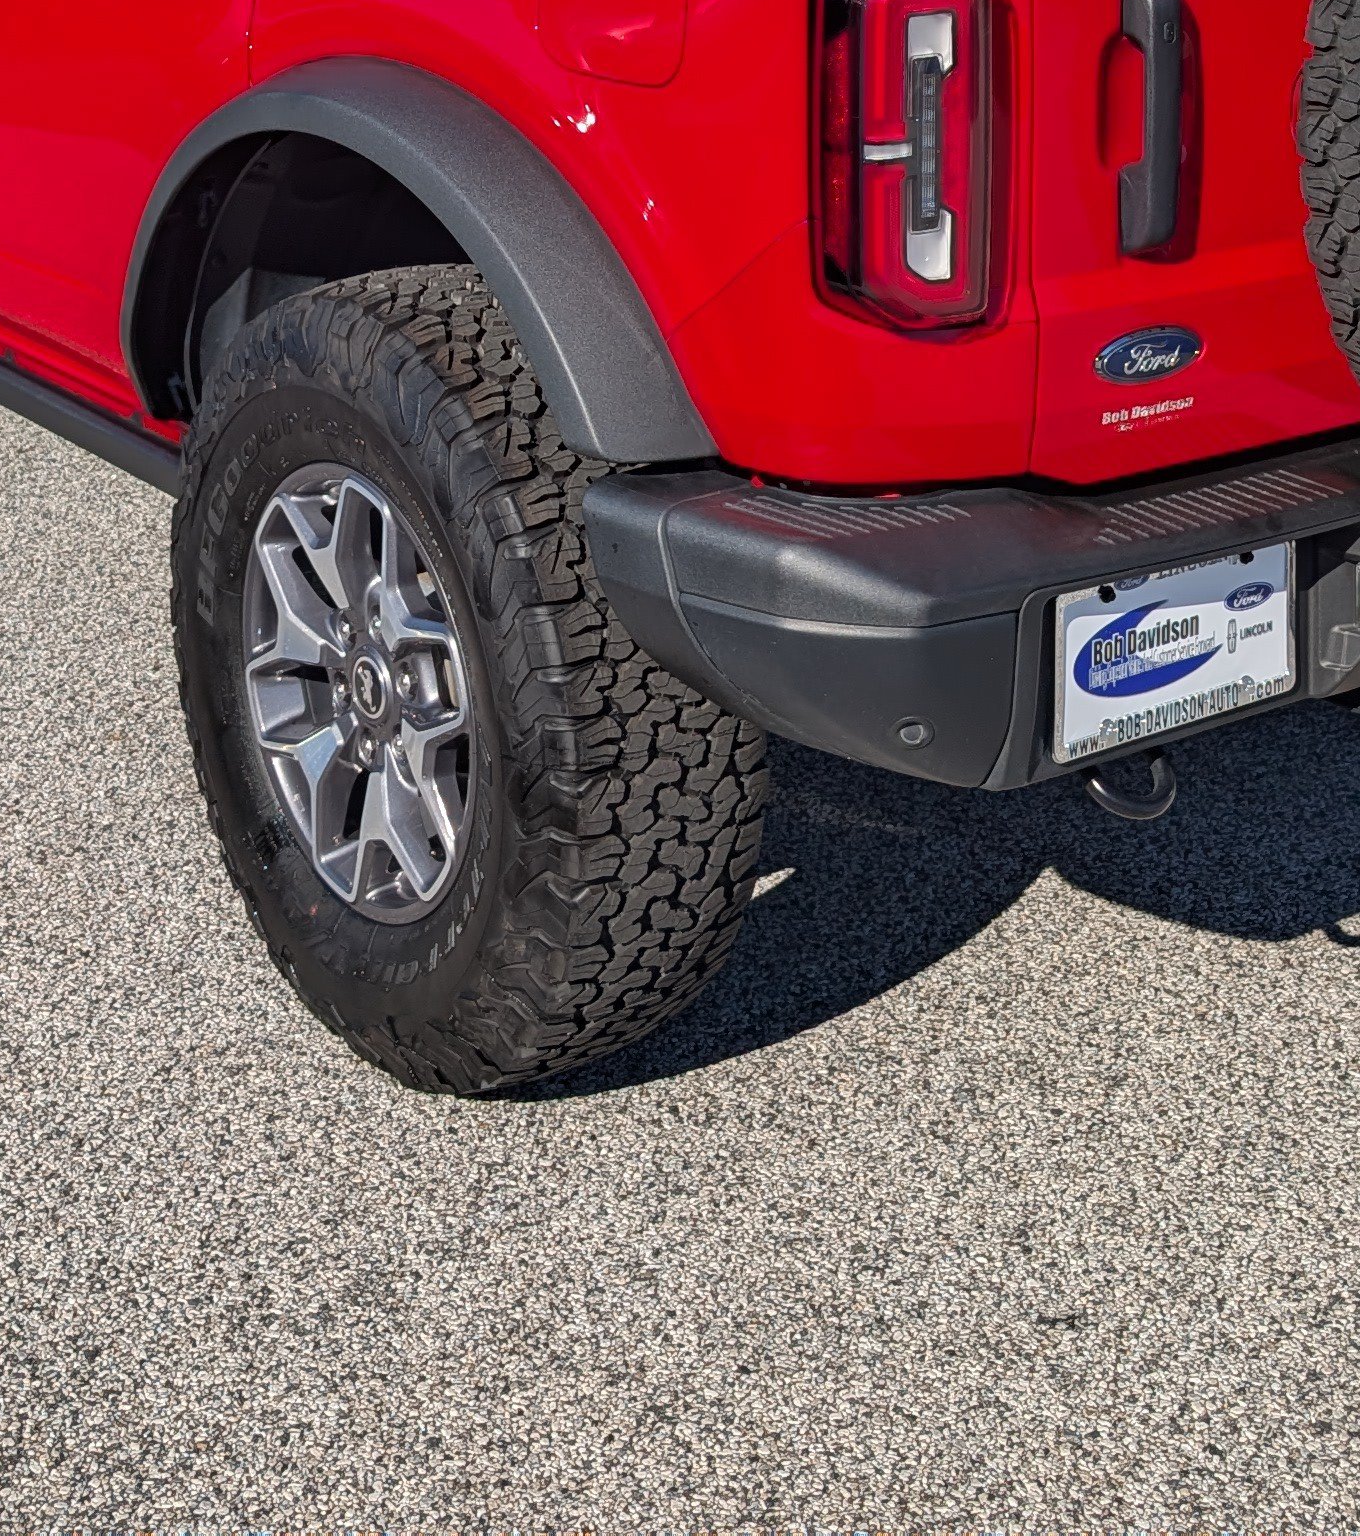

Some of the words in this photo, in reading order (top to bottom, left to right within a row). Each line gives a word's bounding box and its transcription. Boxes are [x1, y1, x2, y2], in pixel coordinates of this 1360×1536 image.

[1123, 340, 1181, 376] Ford
[1102, 408, 1129, 425] Bob
[1131, 396, 1194, 420] Davidson
[1234, 585, 1265, 609] Ford
[1093, 634, 1123, 666] Bob
[1127, 614, 1200, 655] Davidson
[1239, 620, 1273, 641] LINCOLN
[1145, 693, 1205, 734] DAVIDSON
[1208, 682, 1240, 714] AUTO
